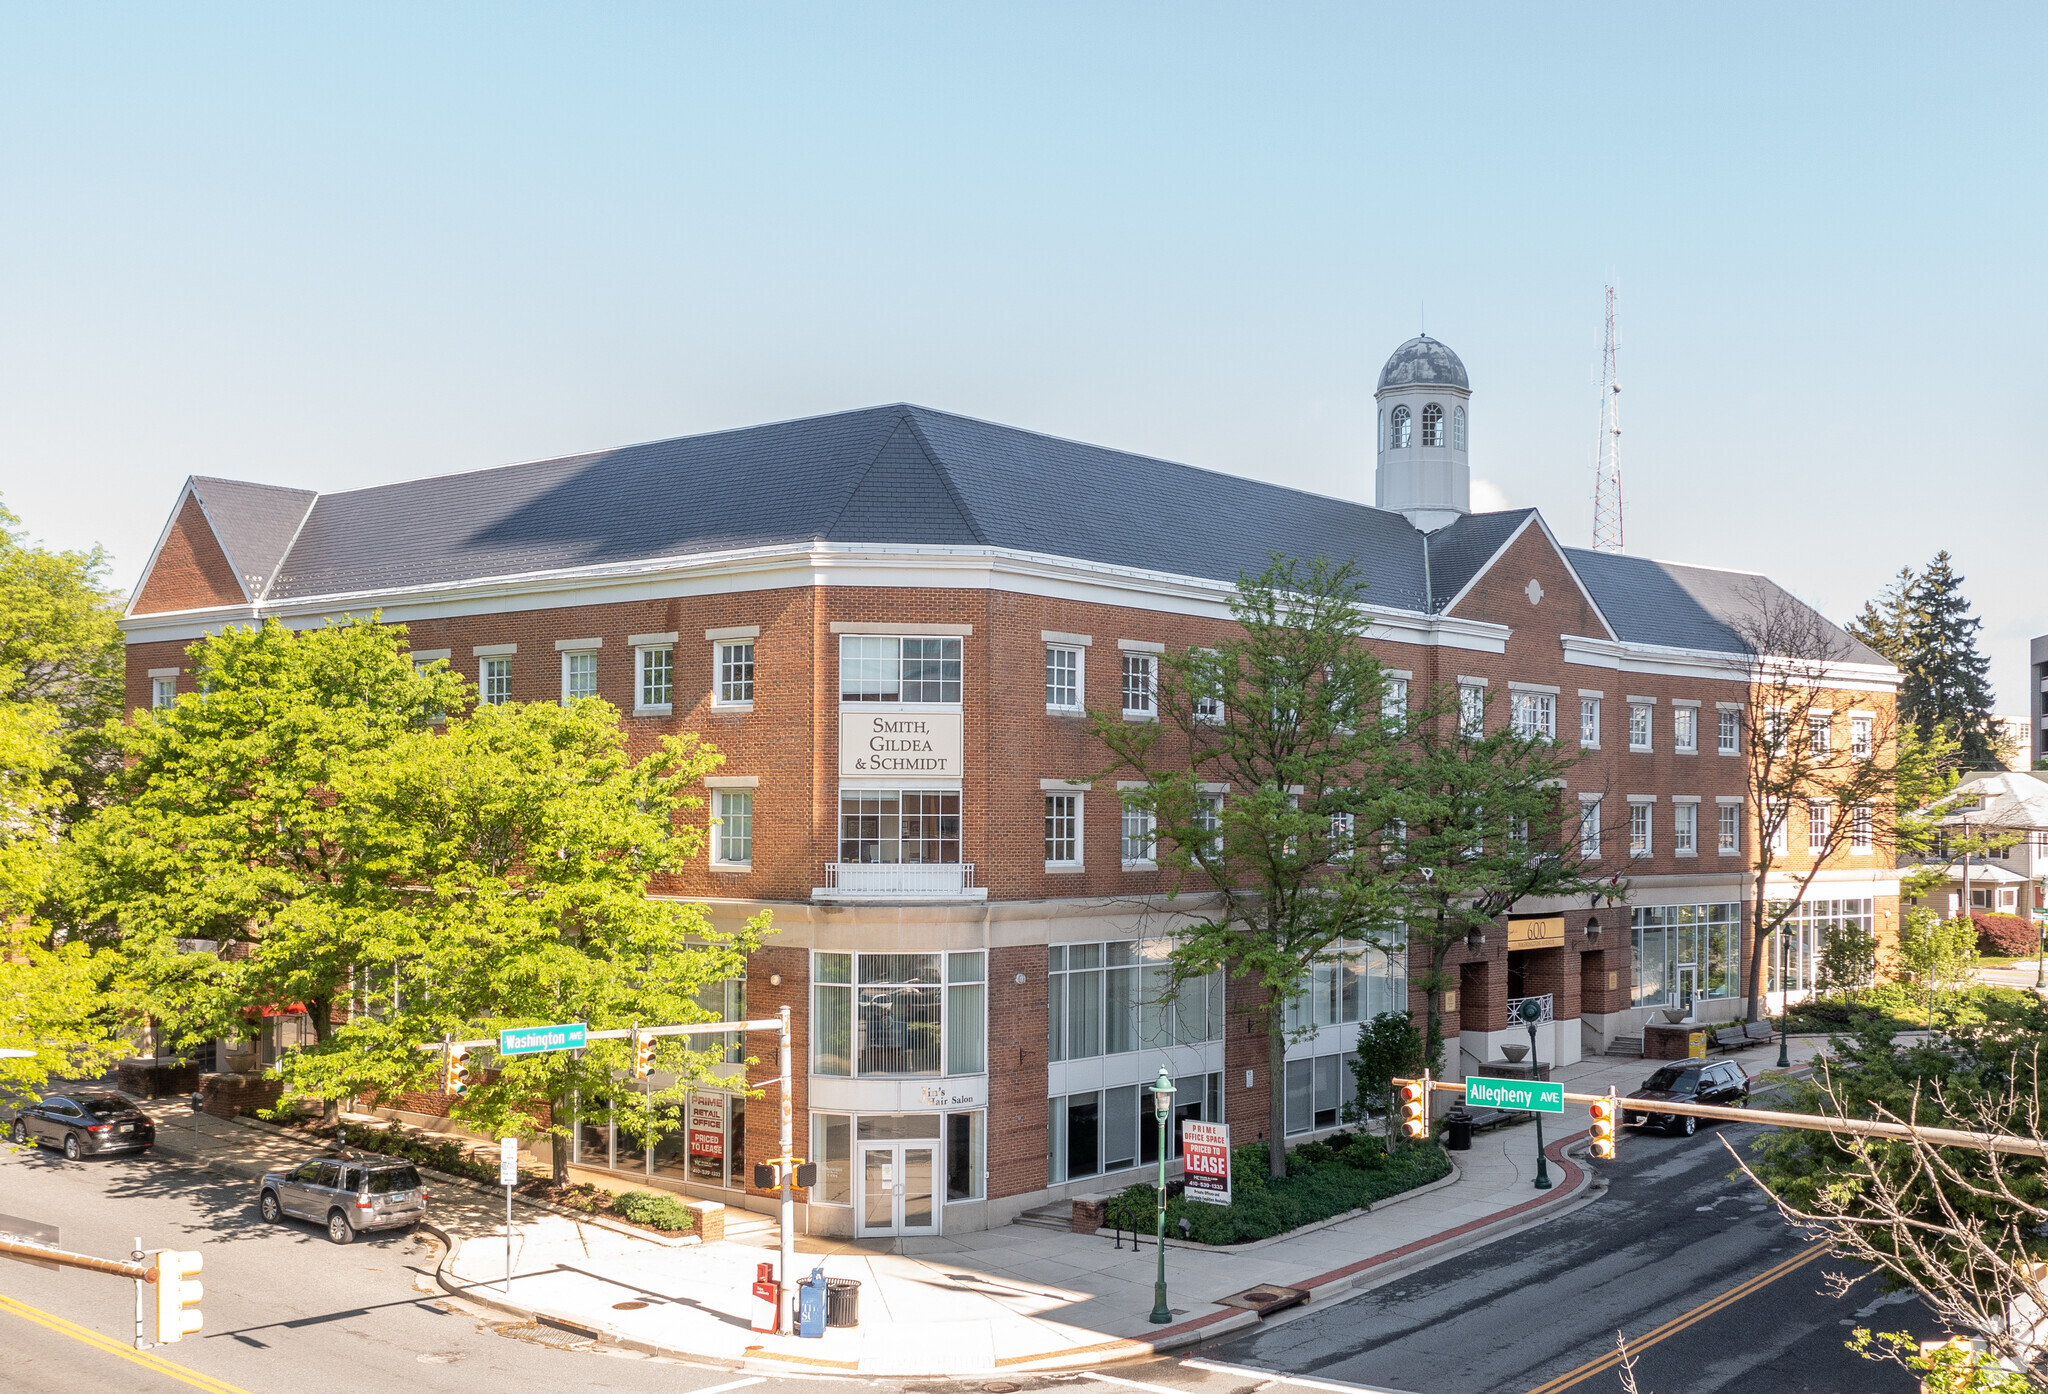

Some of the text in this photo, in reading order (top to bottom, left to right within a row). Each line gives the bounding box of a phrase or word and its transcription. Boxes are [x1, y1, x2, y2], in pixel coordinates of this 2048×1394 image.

[873, 717, 930, 735] SMITH,
[869, 735, 933, 752] GILDEA
[855, 754, 948, 771] & SCHMIDT
[1527, 921, 1546, 940] 600
[505, 1030, 583, 1050] Washington AVE
[691, 1095, 723, 1108] PRIME
[927, 1095, 974, 1106] Hair Salon
[1470, 1083, 1560, 1108] Allegheny AVE
[693, 1108, 720, 1119] RETAIL
[692, 1118, 721, 1129] OFFICE
[1192, 1124, 1217, 1135] PRIME
[694, 1133, 719, 1144] PRICED
[1184, 1132, 1225, 1144] OFFICE SPACE
[691, 1142, 722, 1154] TO LEASE
[1190, 1144, 1220, 1155] PRICED TO
[1186, 1153, 1226, 1175] LEASE
